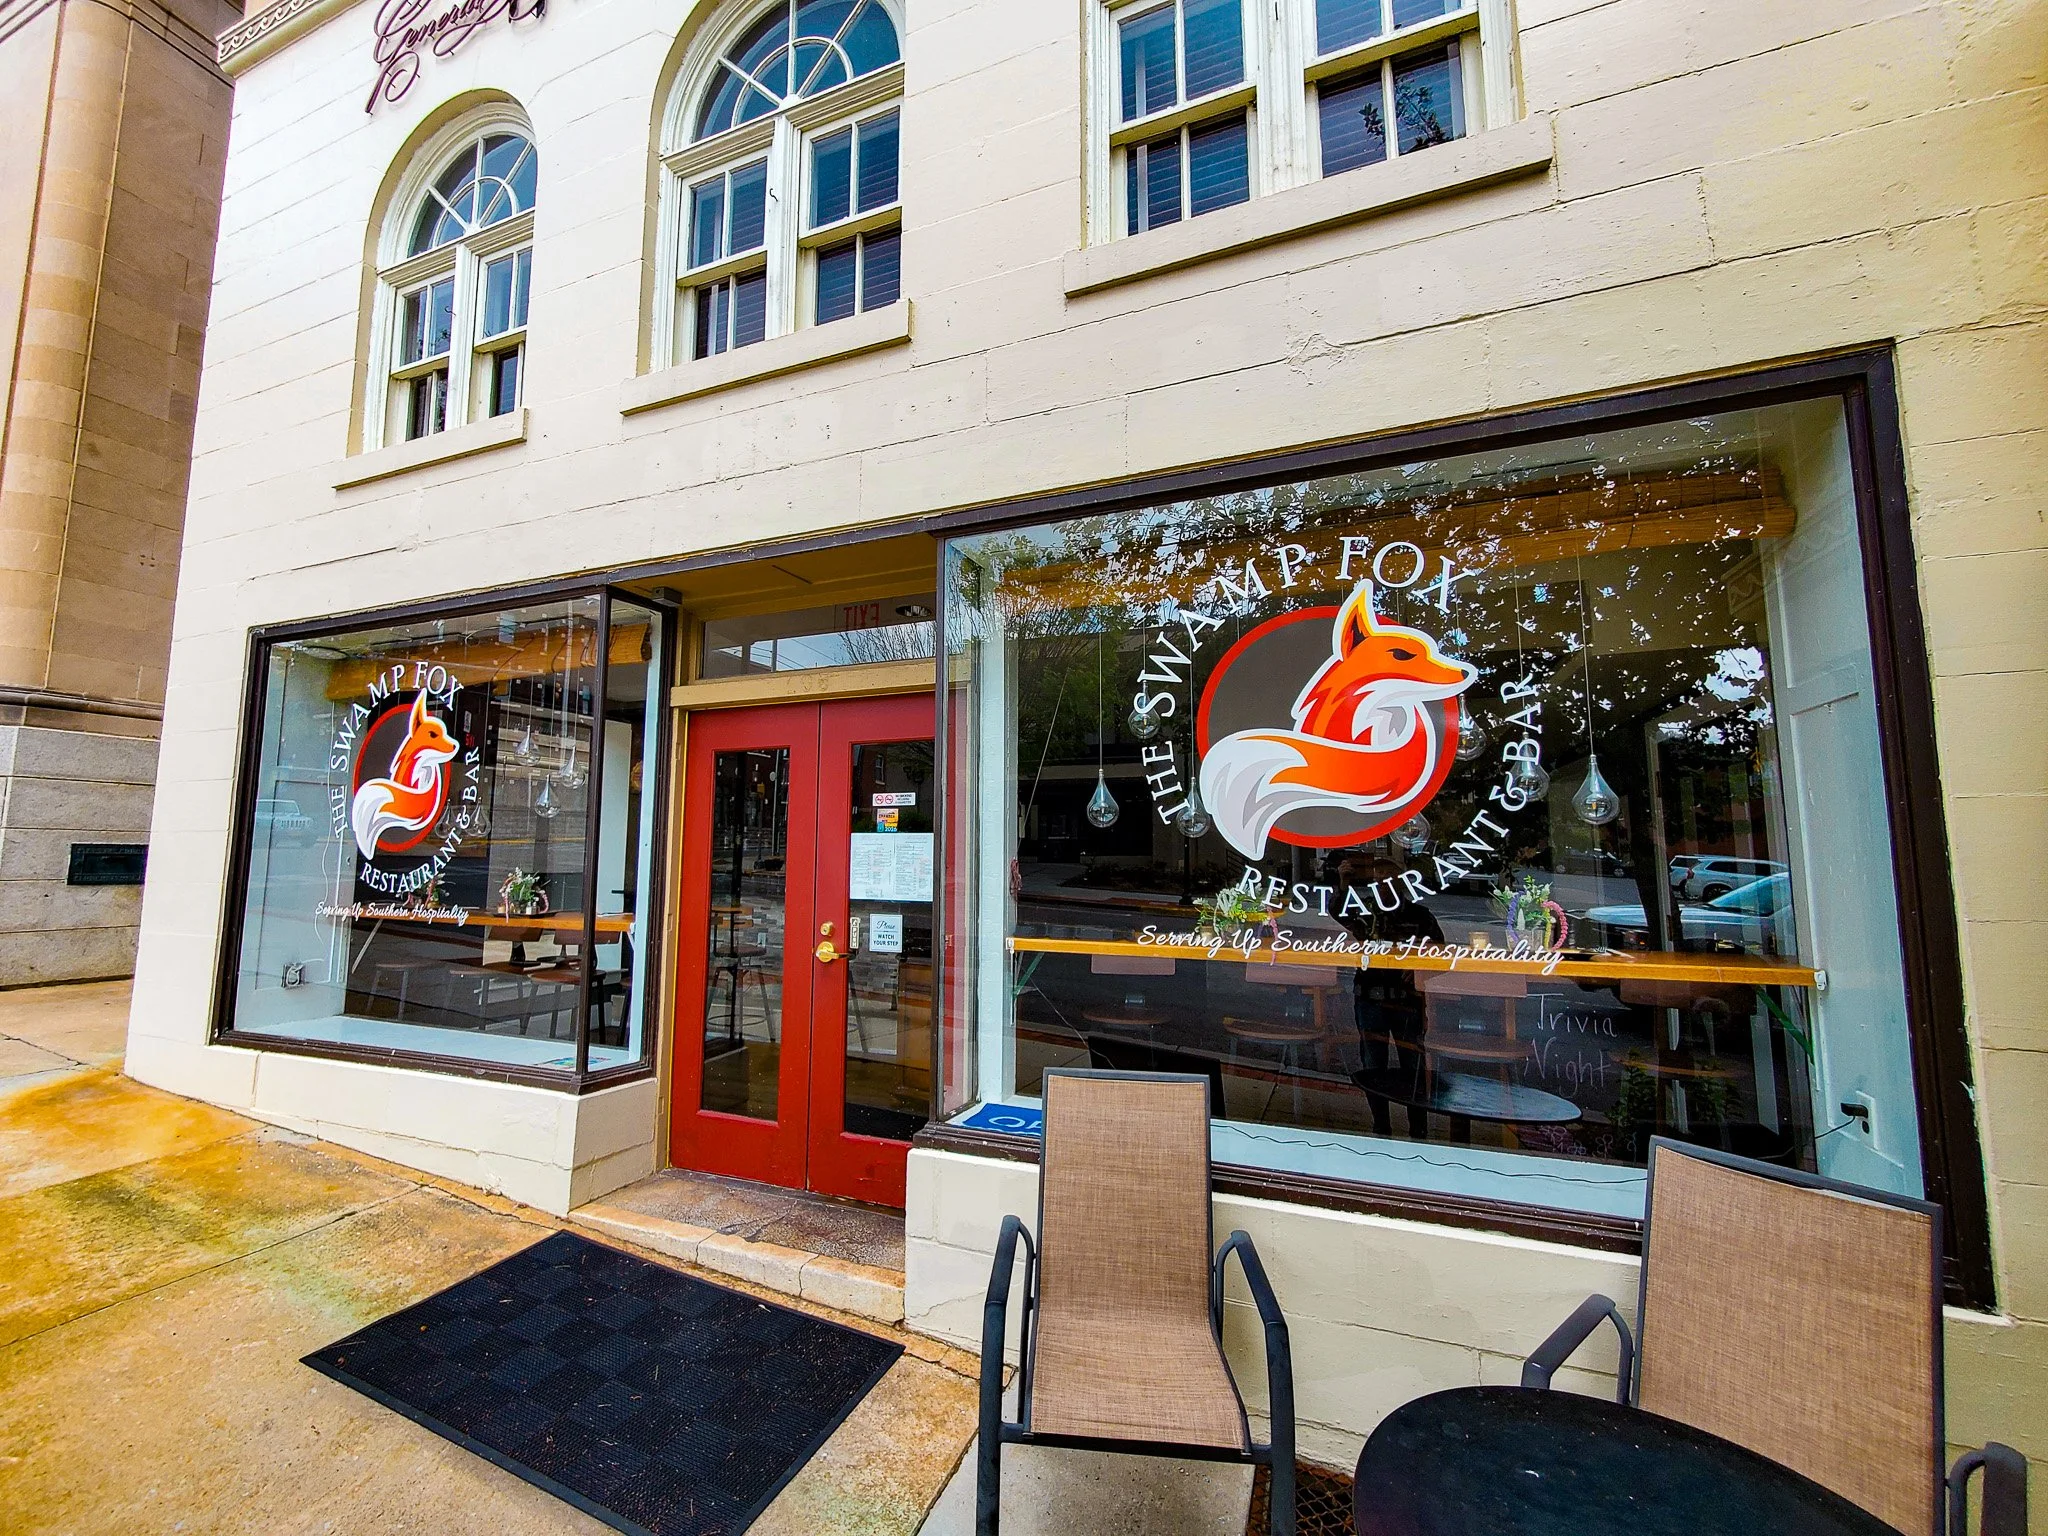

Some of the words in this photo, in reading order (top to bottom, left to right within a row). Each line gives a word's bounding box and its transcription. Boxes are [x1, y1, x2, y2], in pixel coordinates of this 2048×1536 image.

[1335, 536, 1477, 614] FOX
[1135, 543, 1307, 719] SWAMP
[412, 661, 464, 711] FOX
[331, 664, 405, 773] SWAMP
[1503, 672, 1544, 767] BAR
[331, 785, 349, 839] THE
[1142, 740, 1190, 825] THE
[1489, 771, 1529, 812] &
[360, 827, 464, 897] RESTAURANT
[455, 806, 472, 830] &
[464, 746, 480, 802] BAR
[1236, 809, 1510, 918] RESTAURANT
[315, 901, 350, 921] Serving
[350, 902, 364, 921] Up
[366, 902, 409, 918] Southern
[410, 902, 469, 926] Hospitality
[877, 920, 896, 930] Please
[1137, 925, 1225, 958] Serving
[1228, 928, 1262, 959] Up
[1271, 930, 1390, 955] Southern
[1395, 935, 1564, 975] Hospitality
[1527, 993, 1618, 1038] Trivia
[1524, 1037, 1612, 1099] Night
